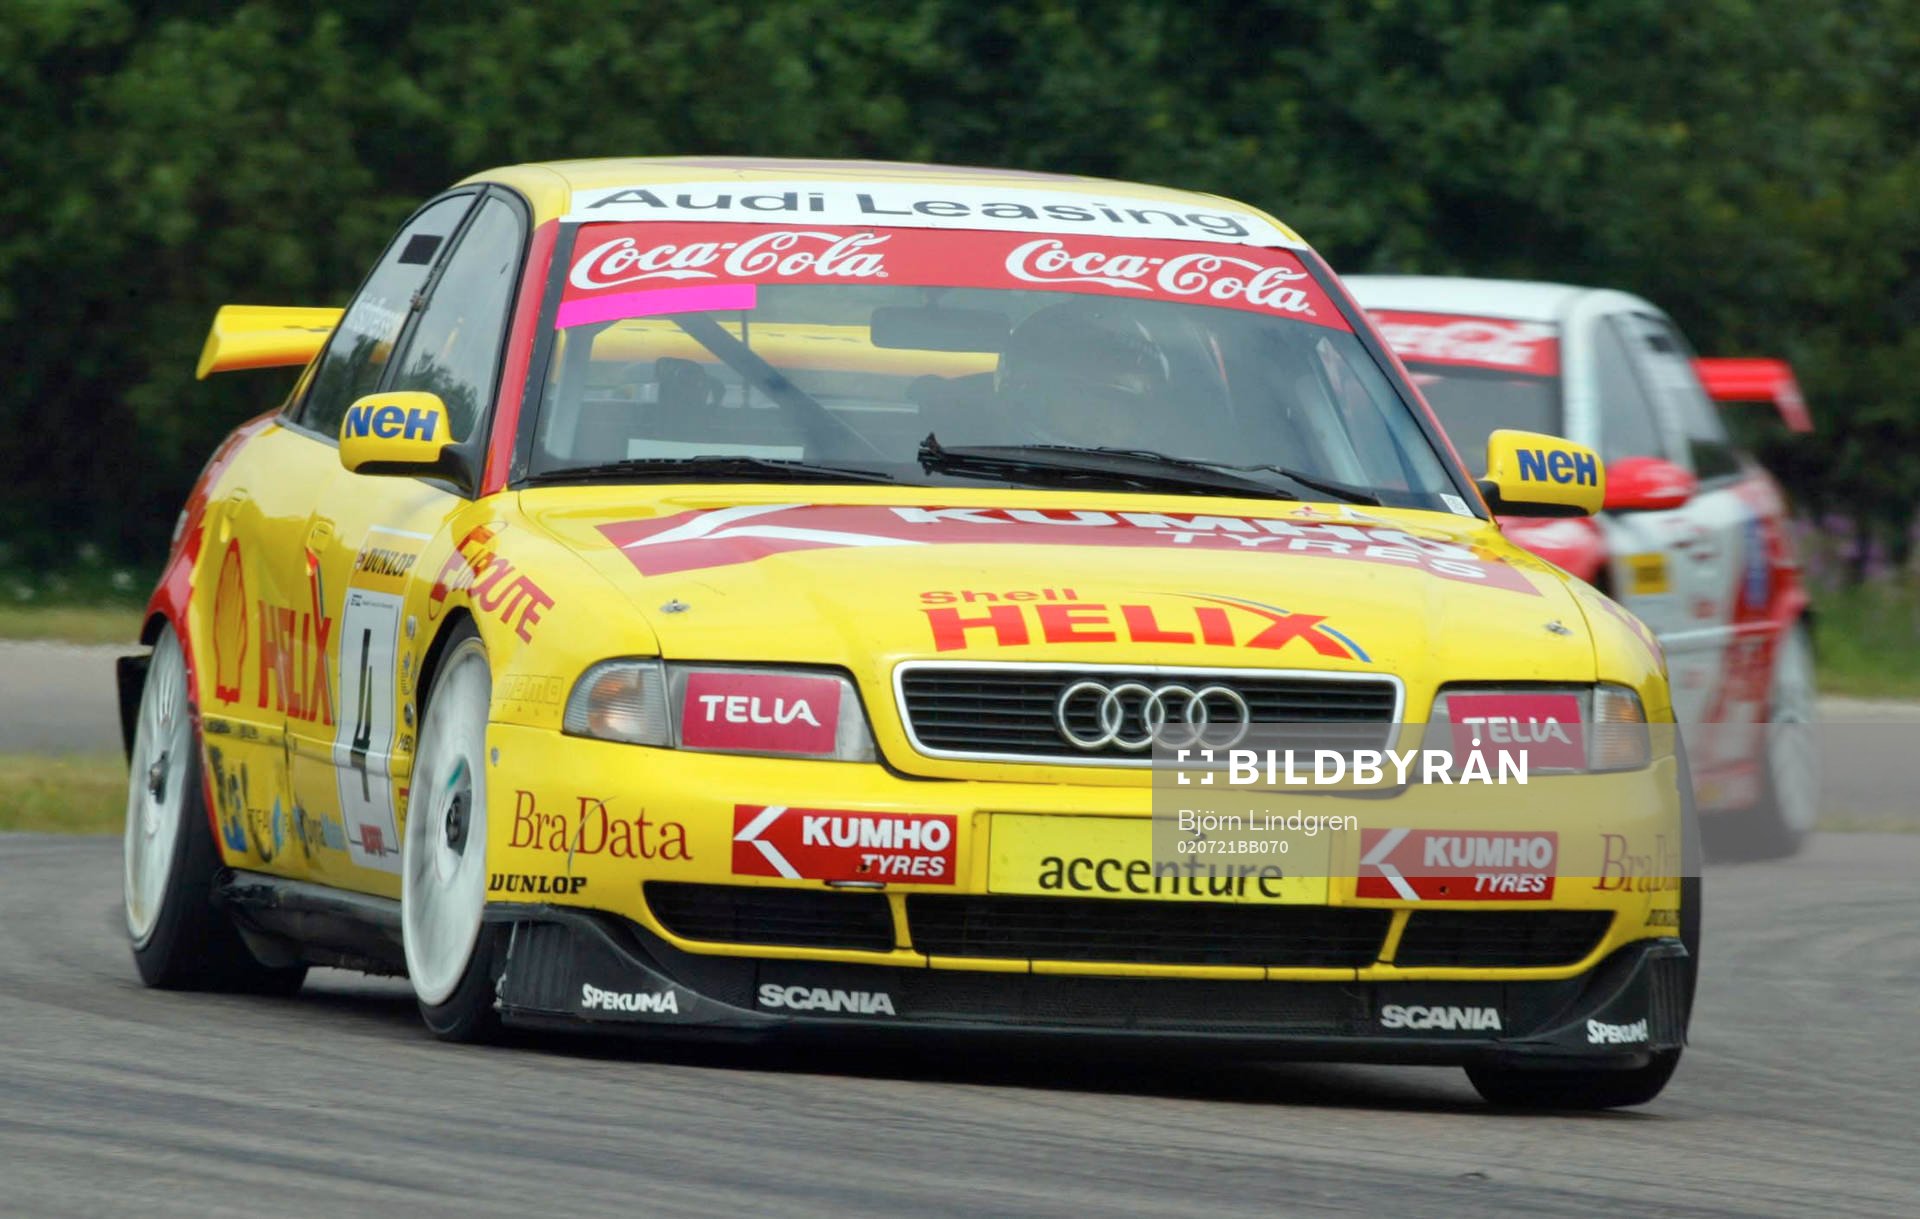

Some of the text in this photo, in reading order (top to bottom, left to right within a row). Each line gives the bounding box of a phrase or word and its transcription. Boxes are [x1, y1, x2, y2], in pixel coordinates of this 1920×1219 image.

[585, 188, 1249, 238] Audi Leasing
[569, 232, 890, 290] Coca-Cola
[1004, 239, 1316, 314] Coca-Cola
[888, 507, 1482, 561] KUMHO
[362, 548, 417, 577] DUNLOP
[1155, 530, 1487, 579] TYRES
[919, 587, 1078, 605] Shell
[258, 560, 333, 728] HELIX
[919, 602, 1356, 662] HELIX
[349, 627, 373, 804] 4
[699, 694, 821, 727] TELIA
[1463, 717, 1573, 744] TELIA
[508, 790, 694, 861] BraData
[802, 815, 951, 852] KUMHO
[860, 853, 946, 877] TYRES
[1424, 836, 1553, 869] KUMHO
[488, 873, 588, 894] DUNLOP
[1039, 853, 1283, 898] accenture
[1474, 872, 1548, 893] TYRES
[582, 983, 679, 1014] SPEKUMA
[758, 983, 895, 1016] SCANIA
[1381, 1004, 1501, 1031] SCANIA
